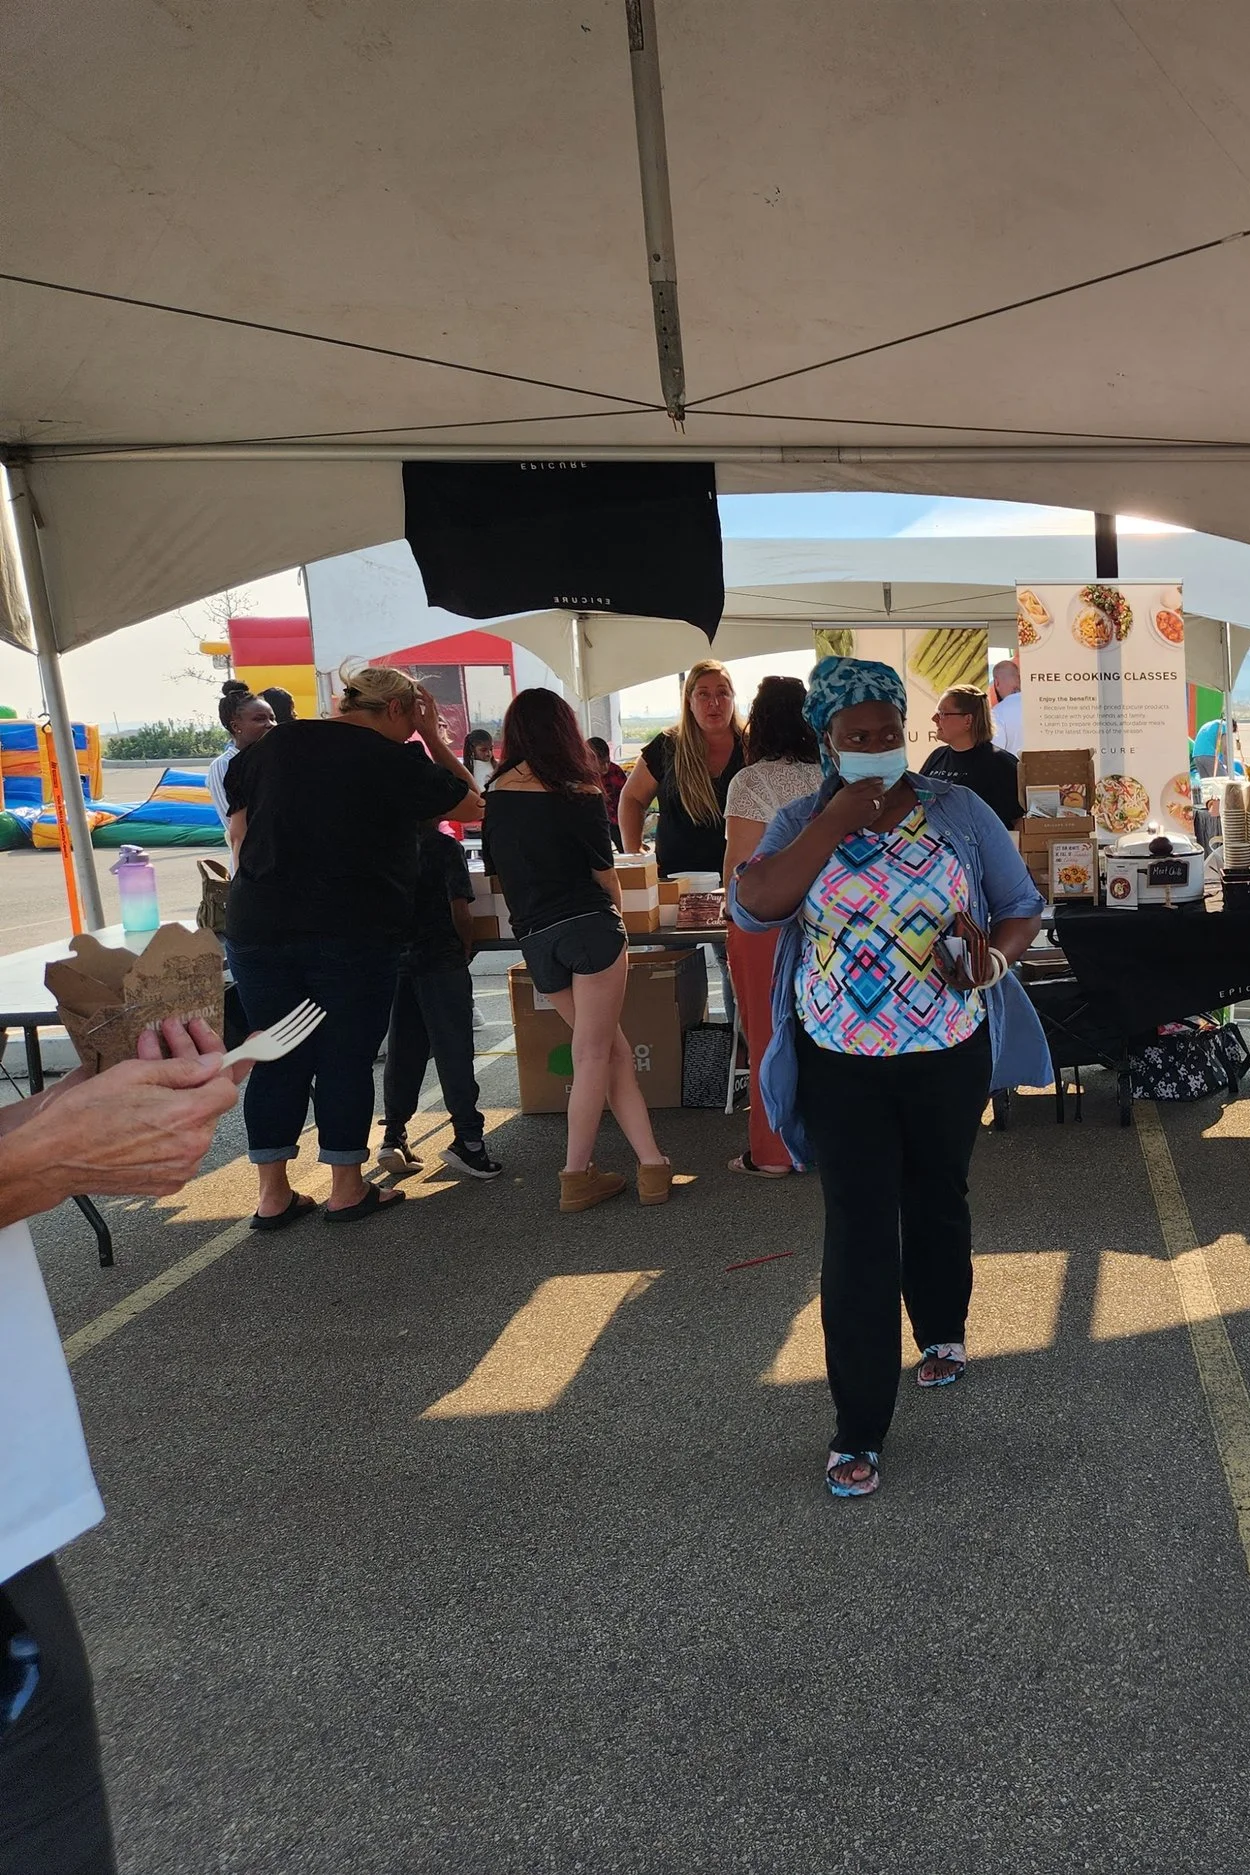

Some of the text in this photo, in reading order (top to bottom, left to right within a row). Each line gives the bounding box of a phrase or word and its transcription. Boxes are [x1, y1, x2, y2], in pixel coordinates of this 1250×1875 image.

[1030, 671, 1178, 682] FREE COOKING CLASSES
[1152, 866, 1168, 876] Meat
[706, 917, 727, 926] Cake
